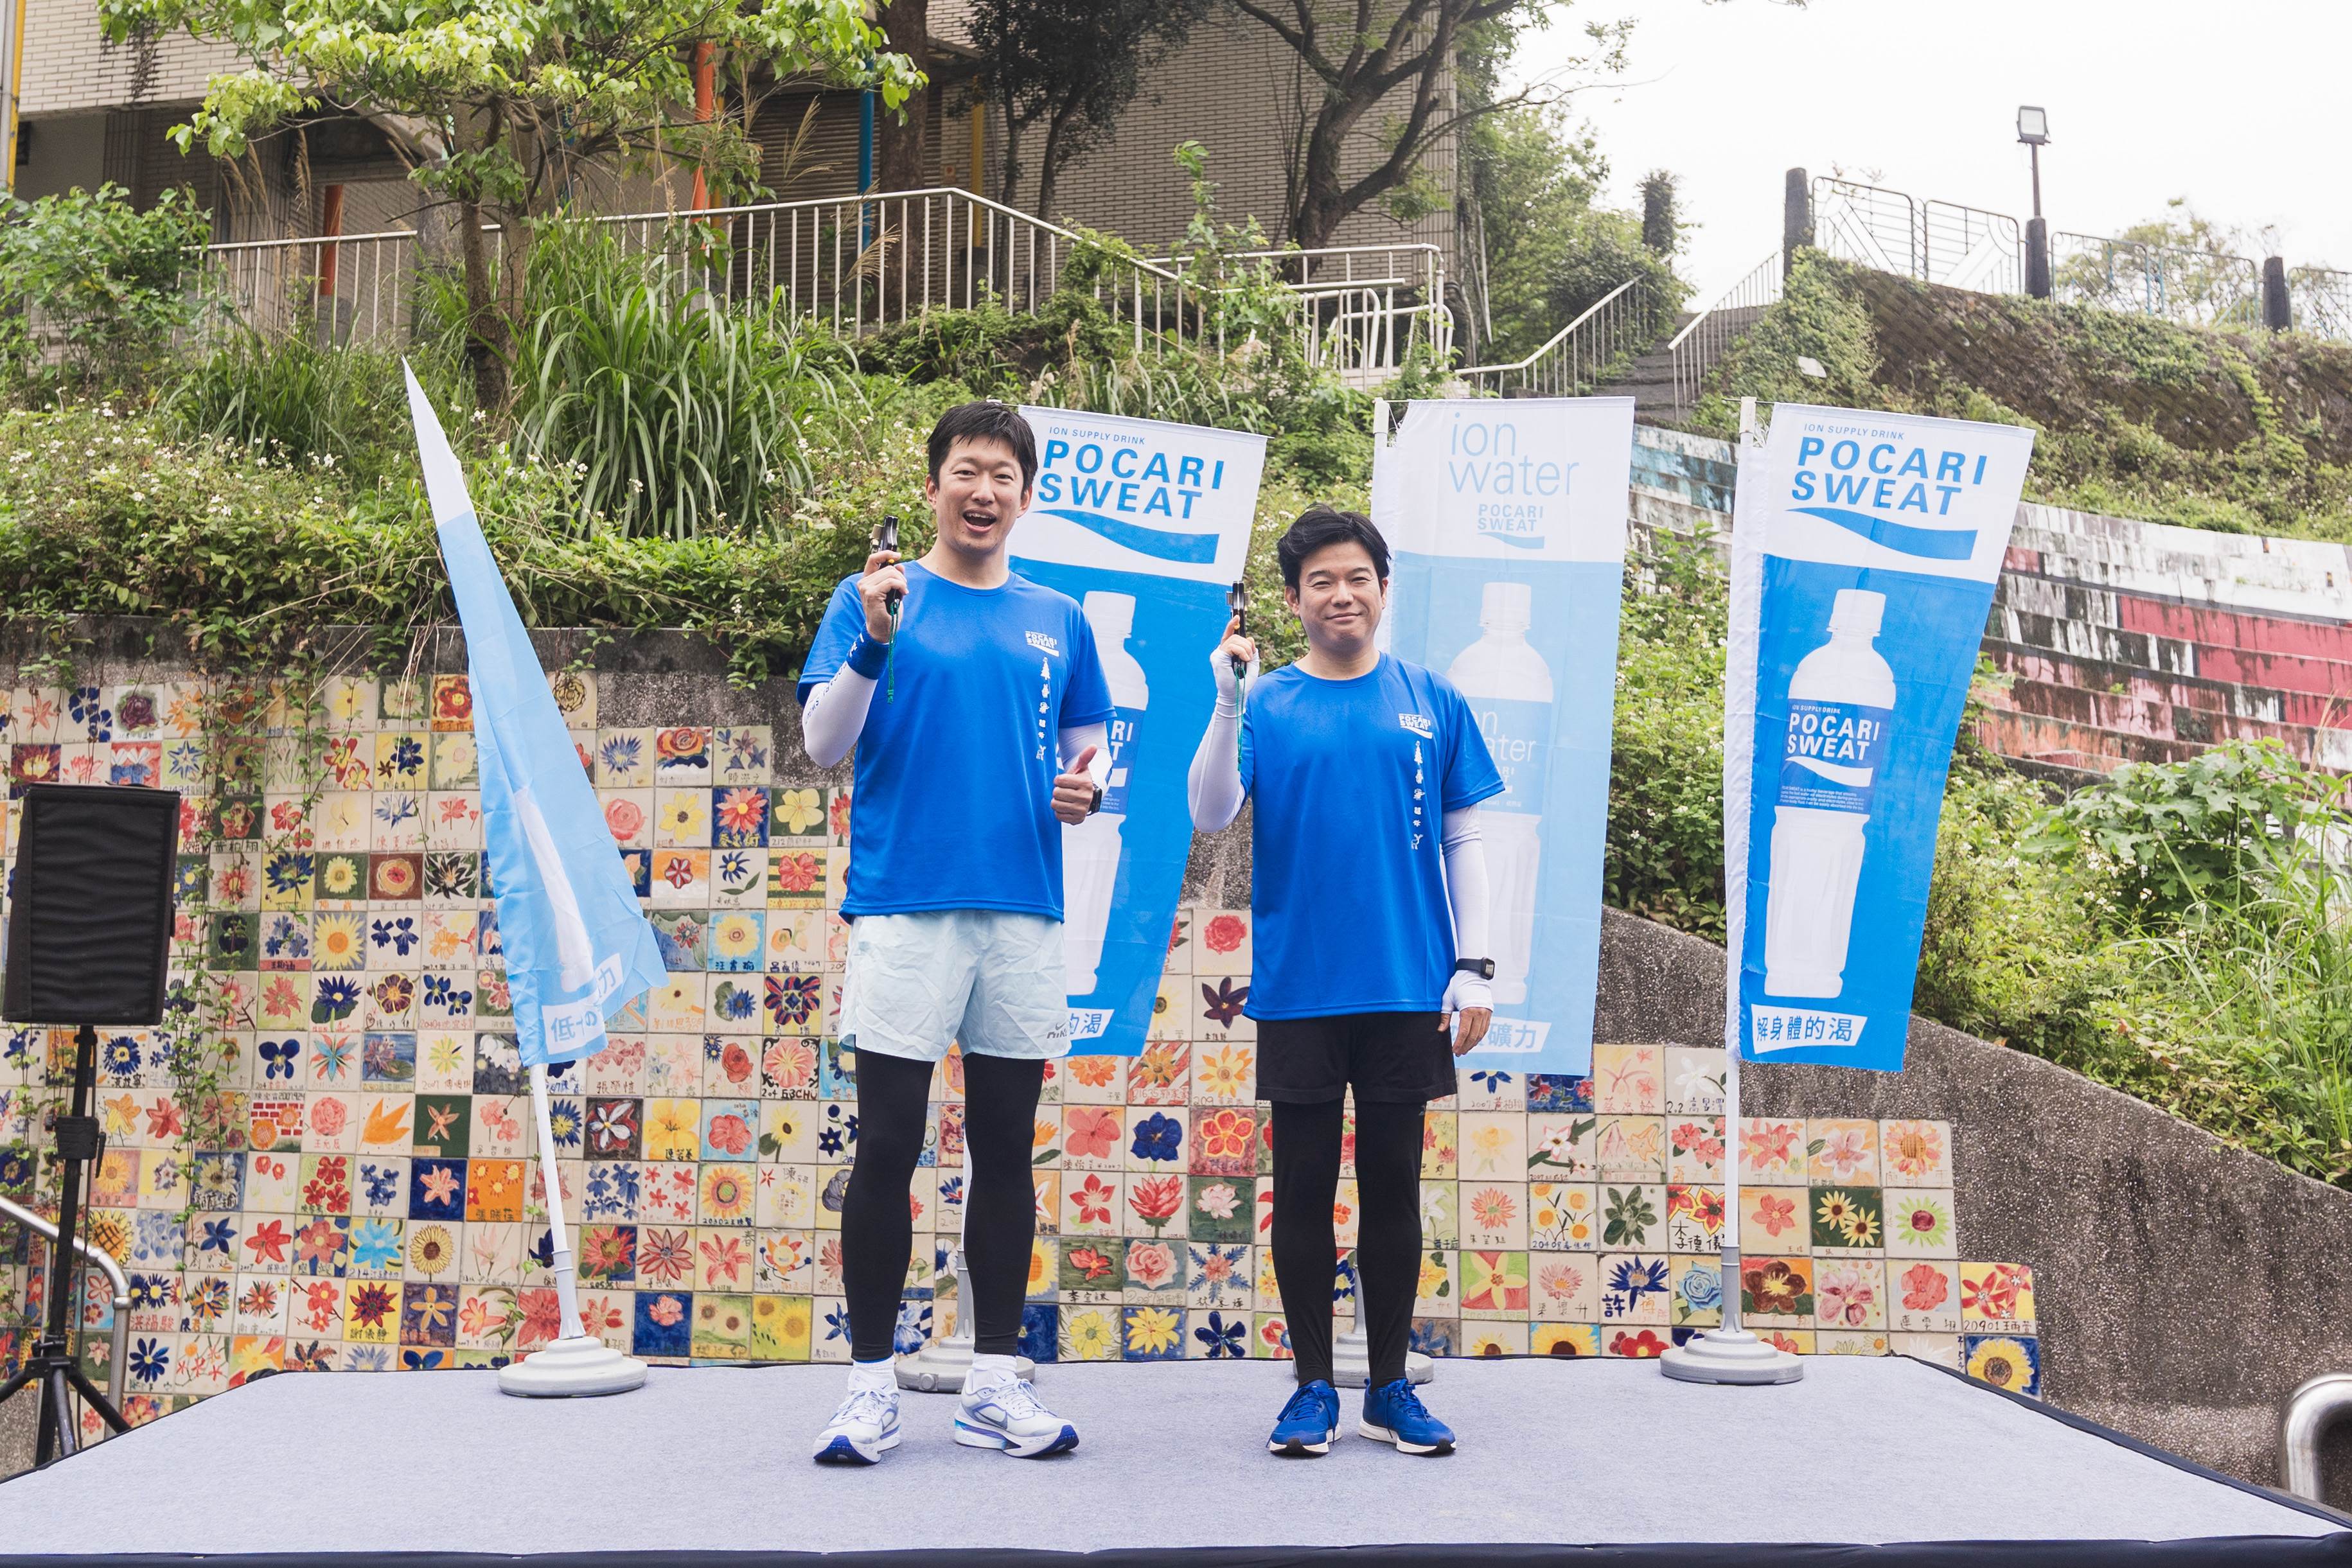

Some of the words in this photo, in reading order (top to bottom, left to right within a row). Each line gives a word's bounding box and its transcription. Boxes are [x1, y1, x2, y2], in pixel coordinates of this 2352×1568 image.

[1049, 427, 1068, 436] ION
[1072, 429, 1110, 441] SUPPLY
[1113, 434, 1145, 445] DRINK
[1451, 412, 1517, 457] ion
[1804, 423, 1825, 433] ION
[1828, 426, 1868, 437] SUPPLY
[1871, 430, 1904, 440] DRINK
[1043, 439, 1225, 490] POCARI
[1797, 436, 1988, 486] POCARI
[1448, 455, 1580, 496] water
[1038, 473, 1203, 519] SWEAT
[1791, 470, 1962, 515] SWEAT
[1478, 504, 1543, 518] POCARI
[1478, 517, 1537, 532] SWEAT
[1399, 715, 1431, 726] POCARI
[1789, 712, 1880, 741] POCARI
[1787, 734, 1870, 761] SWEAT
[1756, 1016, 1853, 1042] 解身體的渴
